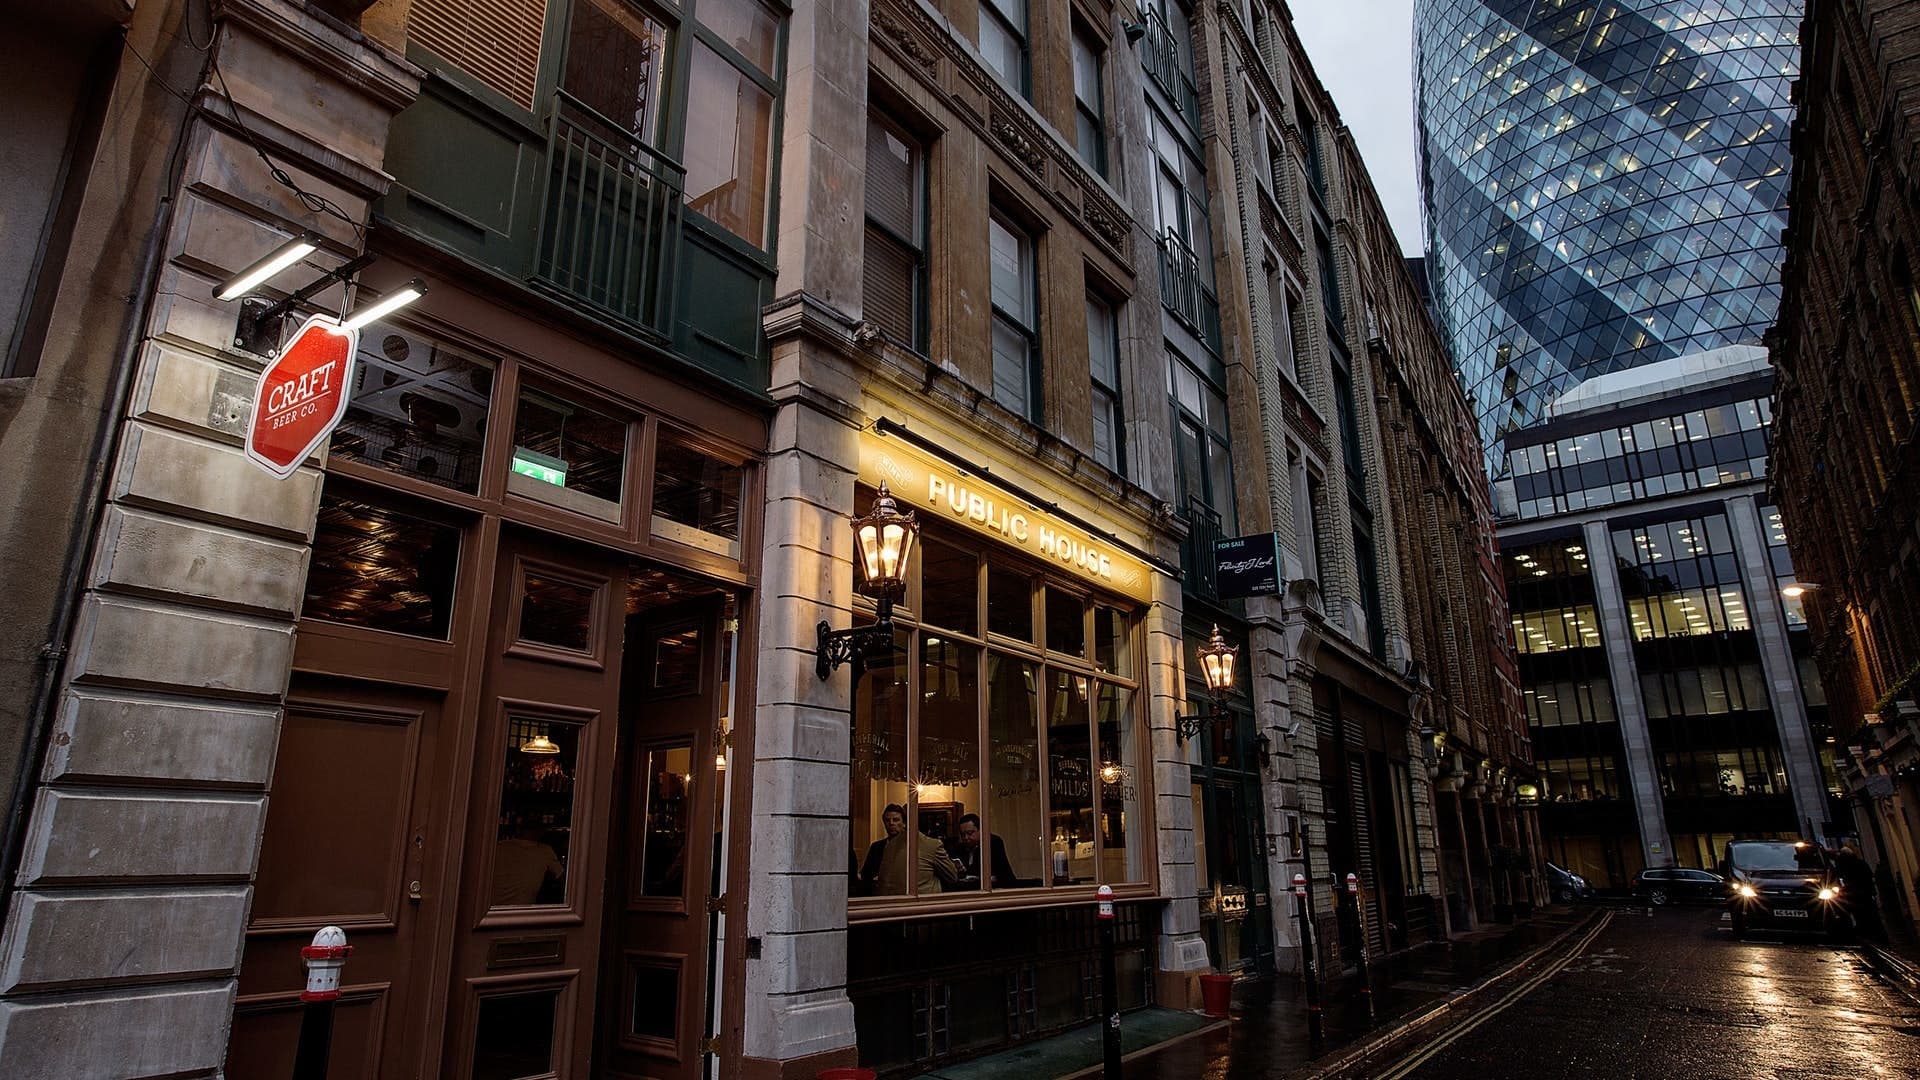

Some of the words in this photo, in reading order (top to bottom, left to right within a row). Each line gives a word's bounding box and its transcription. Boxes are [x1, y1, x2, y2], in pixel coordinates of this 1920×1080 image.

[268, 360, 336, 414] CRAFT
[272, 411, 297, 430] BEER
[300, 402, 318, 417] CO.
[928, 472, 1029, 542] PUBLIC
[1039, 525, 1113, 582] HOUSE
[1231, 540, 1245, 548] SALE
[1053, 778, 1089, 798] MILDS
